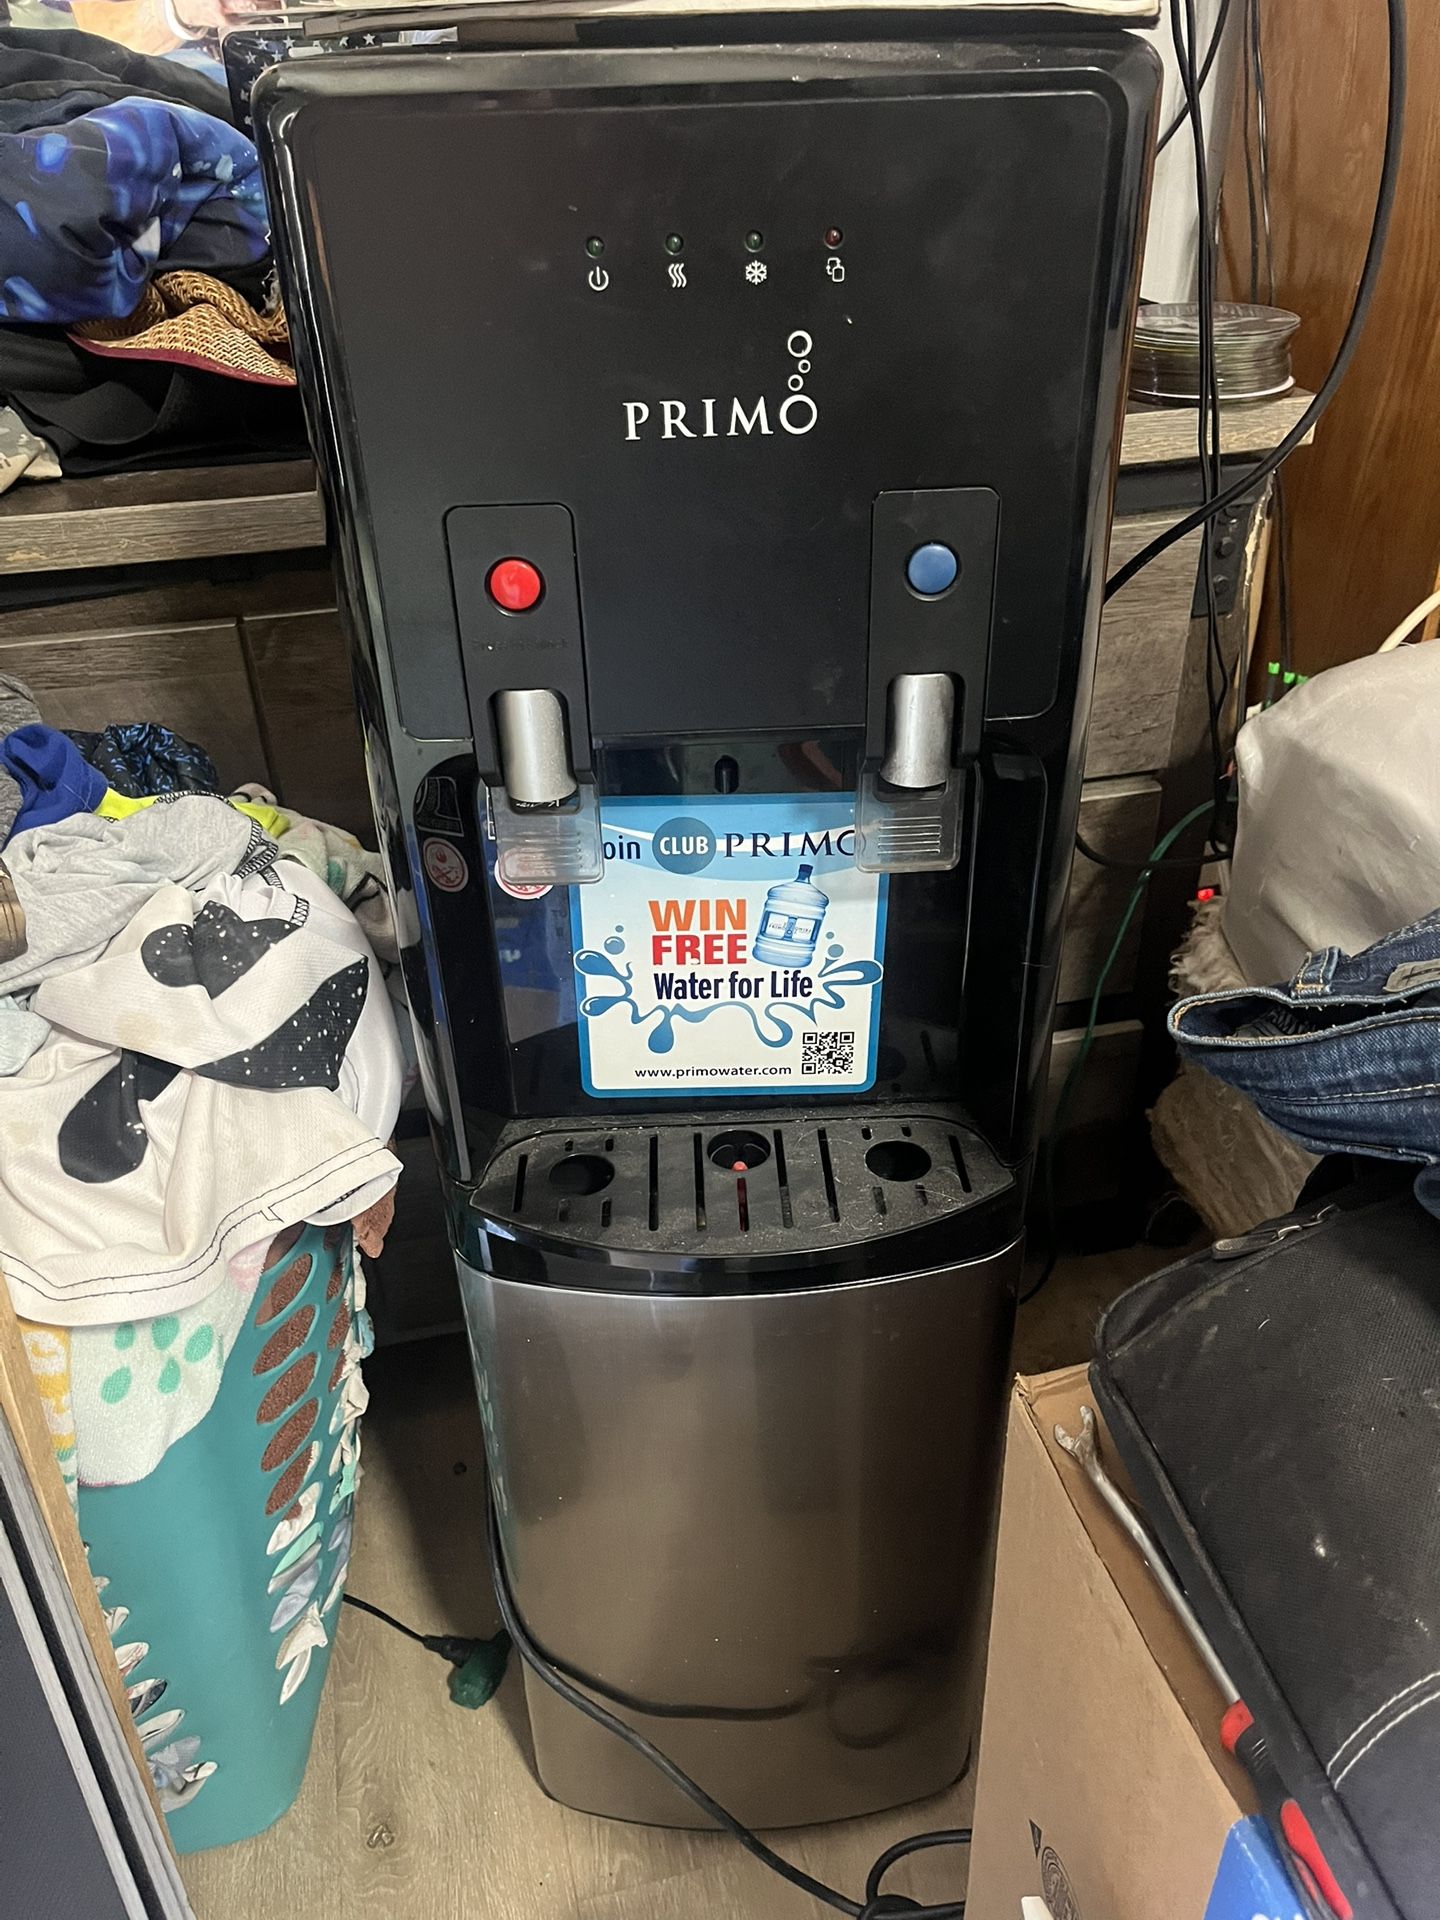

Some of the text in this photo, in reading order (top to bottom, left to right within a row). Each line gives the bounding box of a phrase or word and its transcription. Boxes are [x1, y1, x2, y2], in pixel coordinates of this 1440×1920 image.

[622, 394, 818, 441] PRIMO
[603, 835, 641, 860] oin
[660, 836, 709, 855] CLUB
[648, 899, 747, 931] WIN
[652, 934, 747, 965] FREE
[654, 970, 813, 1000] Water for Life
[634, 1066, 792, 1079] www.primowater.com
